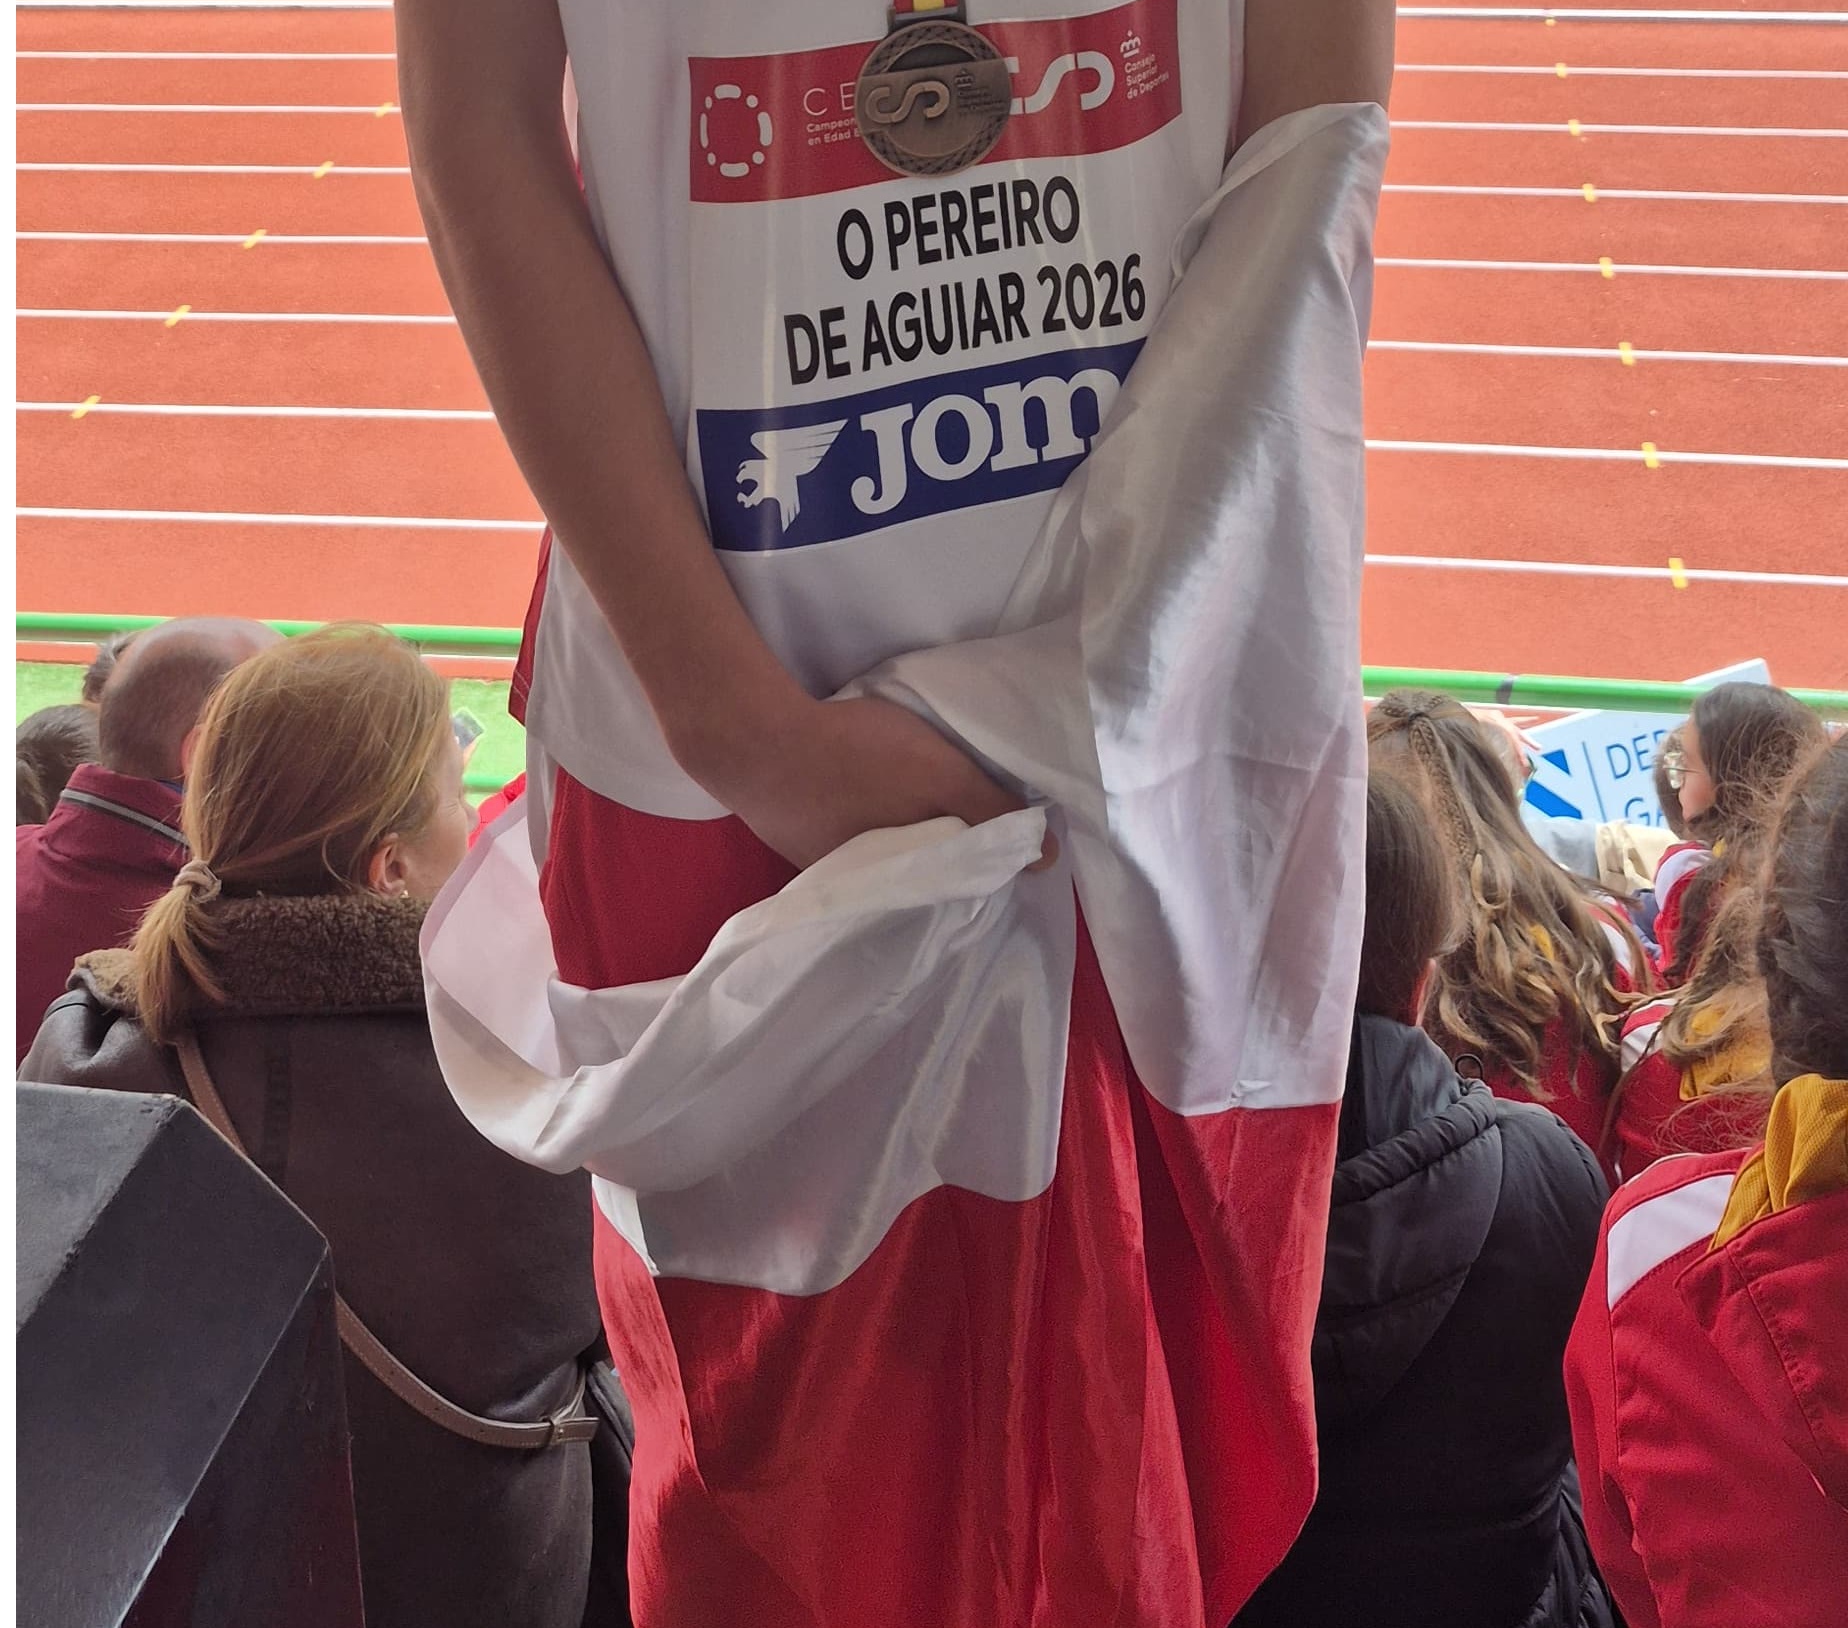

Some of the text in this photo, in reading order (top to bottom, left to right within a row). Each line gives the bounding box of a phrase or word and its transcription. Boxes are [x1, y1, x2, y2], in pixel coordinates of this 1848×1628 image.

[803, 82, 856, 116] CE
[1127, 87, 1138, 99] de
[806, 117, 857, 133] Campeon
[807, 137, 821, 146] en
[823, 129, 851, 143] Edad
[836, 175, 1080, 280] O PEREIRO
[784, 253, 1146, 385] DE AGUIAR 2026
[1606, 729, 1668, 779] DE
